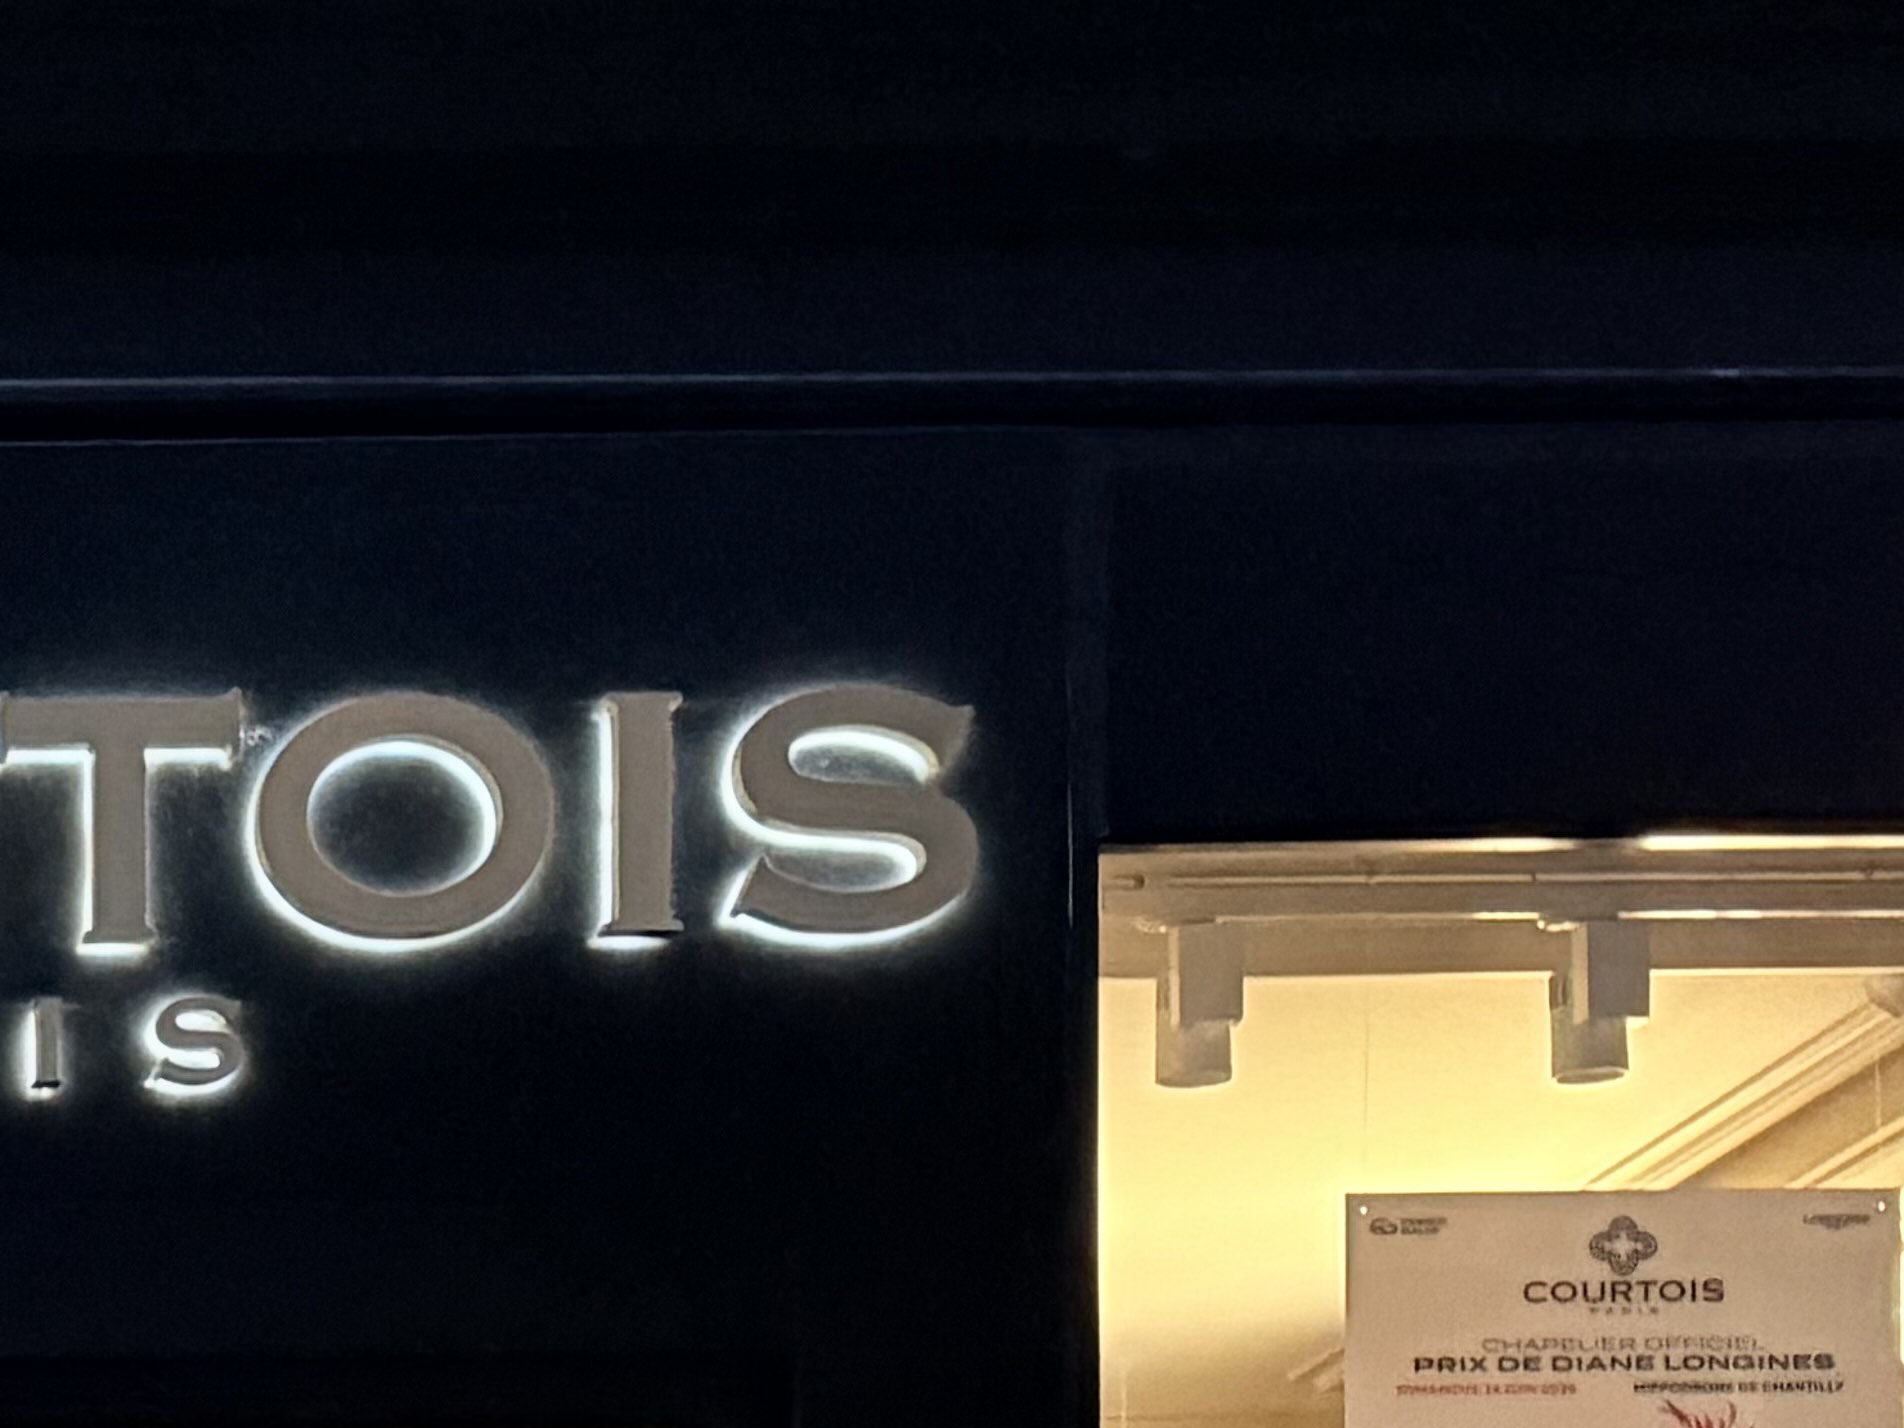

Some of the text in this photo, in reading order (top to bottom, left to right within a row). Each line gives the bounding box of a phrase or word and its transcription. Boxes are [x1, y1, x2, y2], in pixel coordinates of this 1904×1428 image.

[1523, 1278, 1724, 1303] COURTOIS
[1482, 1334, 1765, 1352] CHAPELIER OFFICIEL
[1413, 1353, 1836, 1374] PRIX DE DIANE LONGINES
